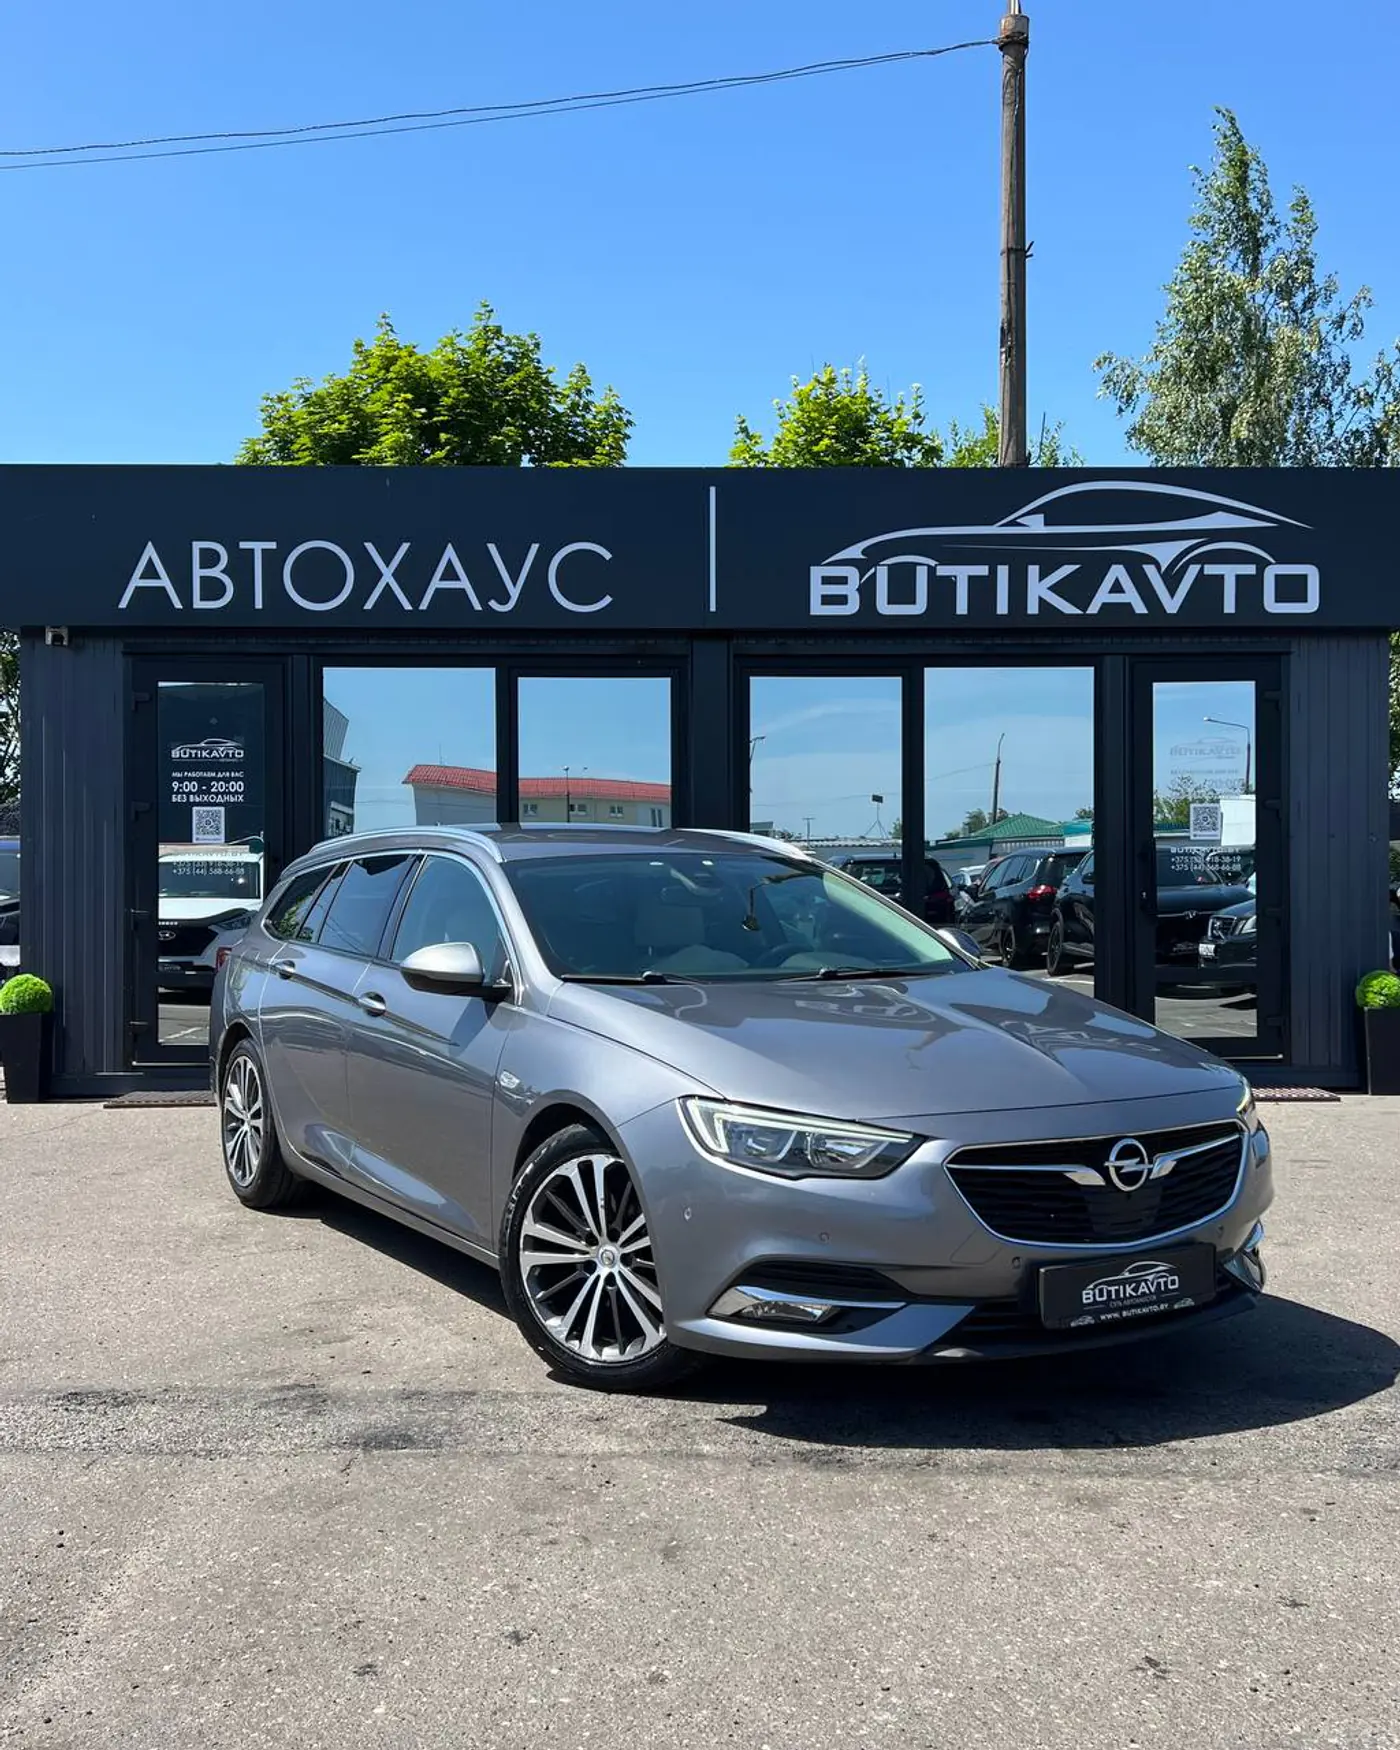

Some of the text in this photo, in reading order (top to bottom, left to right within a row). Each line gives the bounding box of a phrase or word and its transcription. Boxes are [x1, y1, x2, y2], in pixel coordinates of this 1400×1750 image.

[118, 540, 613, 613] АВТОХАУС
[809, 563, 1320, 617] BUTIKAVTO
[171, 749, 244, 758] BUTIKAVTO
[172, 781, 198, 792] 9:00
[210, 781, 244, 792] 20:00
[172, 794, 244, 803] БЕЗ ВЫХОДНЫХ
[1082, 1275, 1179, 1304] BUTIKAVTO
